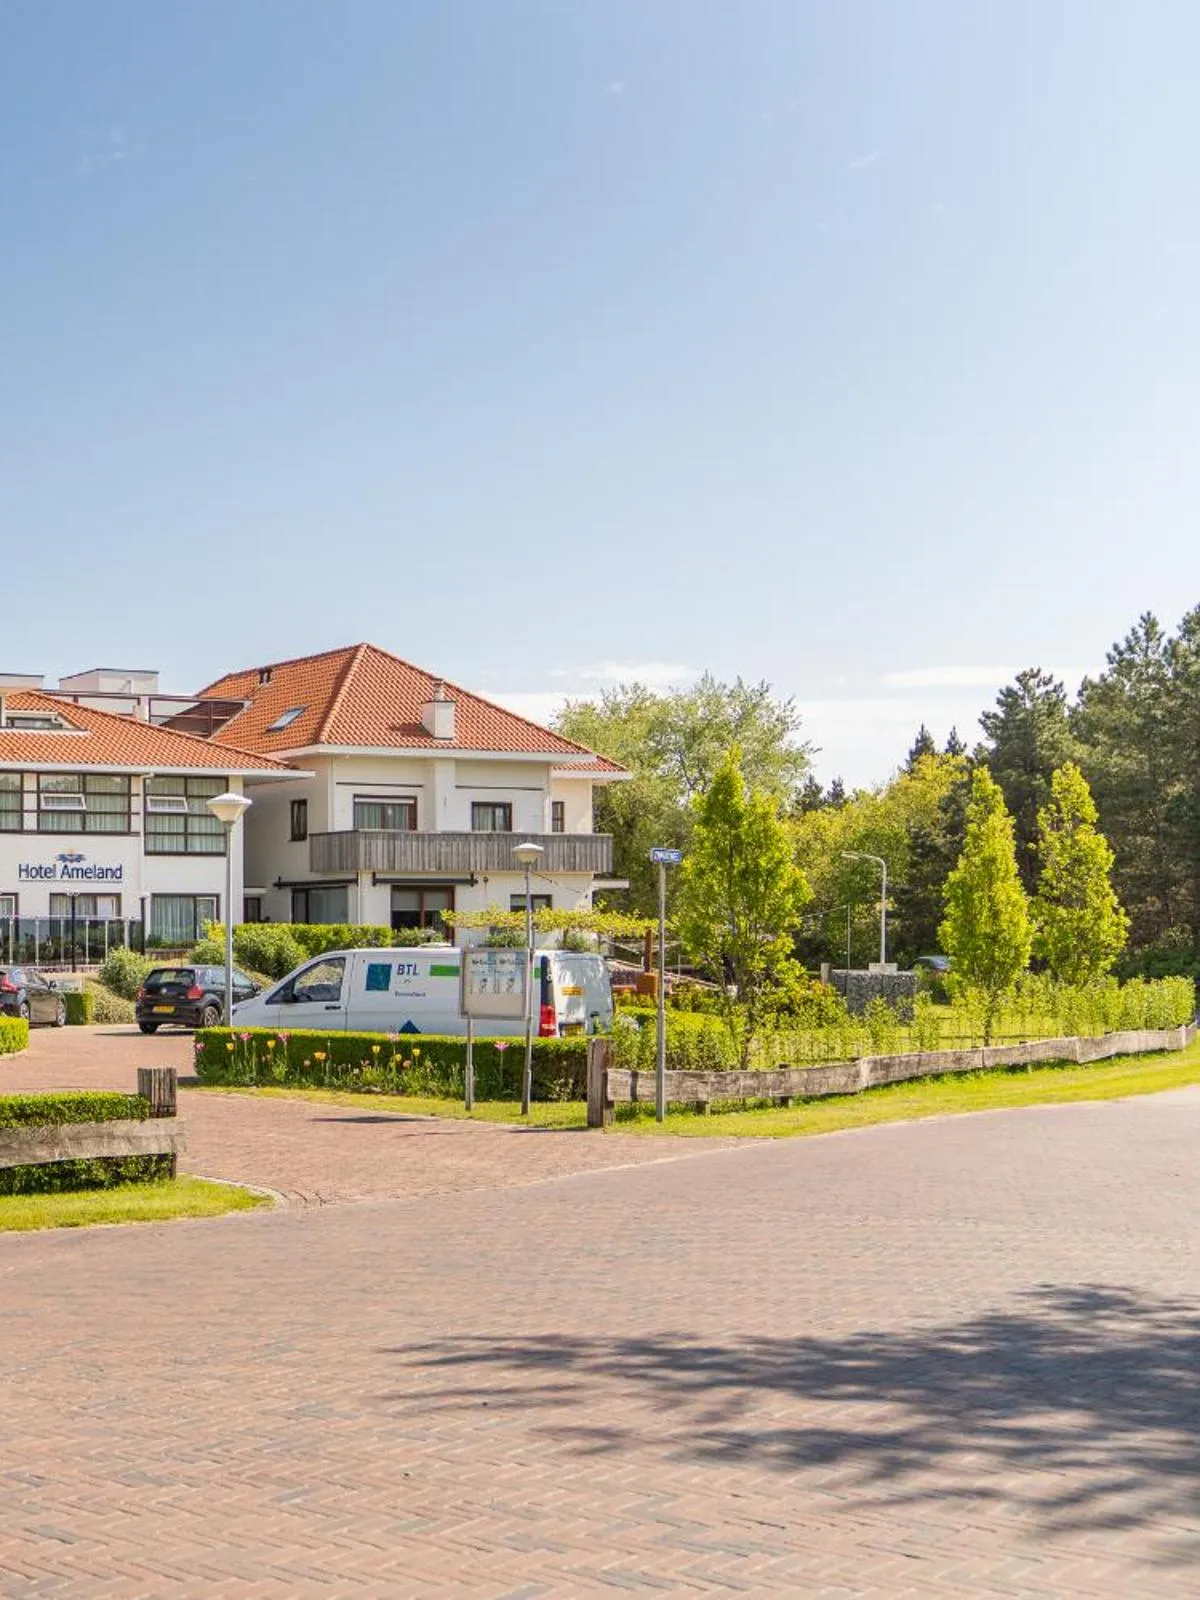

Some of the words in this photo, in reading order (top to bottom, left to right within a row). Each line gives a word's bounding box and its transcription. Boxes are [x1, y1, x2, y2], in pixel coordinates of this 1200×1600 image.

[18, 864, 56, 879] Hotel
[60, 864, 122, 879] Ameland
[397, 963, 419, 976] BTL
